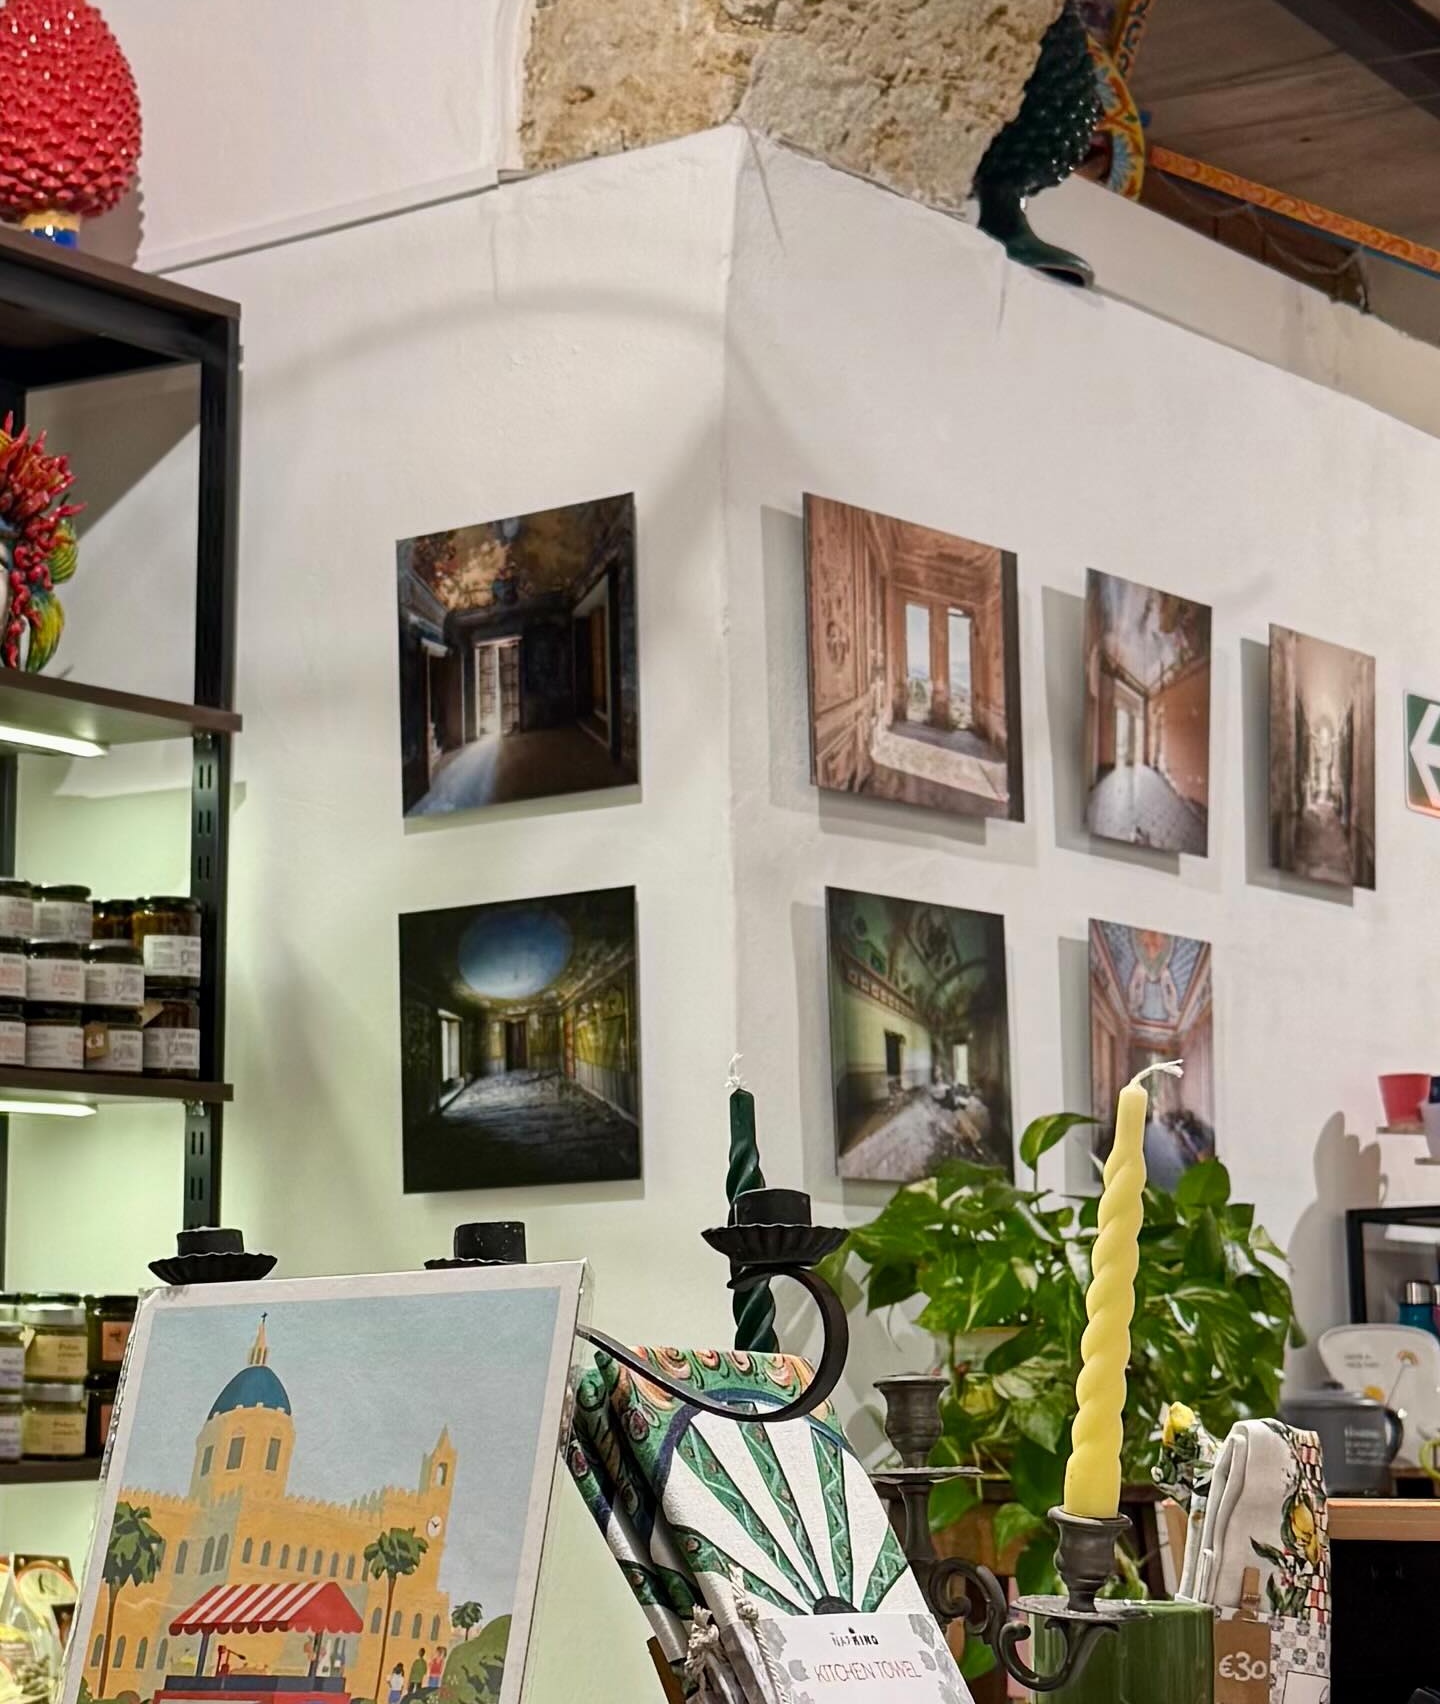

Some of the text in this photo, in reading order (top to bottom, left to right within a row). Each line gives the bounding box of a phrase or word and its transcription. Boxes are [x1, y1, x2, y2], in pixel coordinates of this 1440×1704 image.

[813, 1659, 923, 1684] KITCHEN TOWEL
[1218, 1651, 1268, 1682] €30
